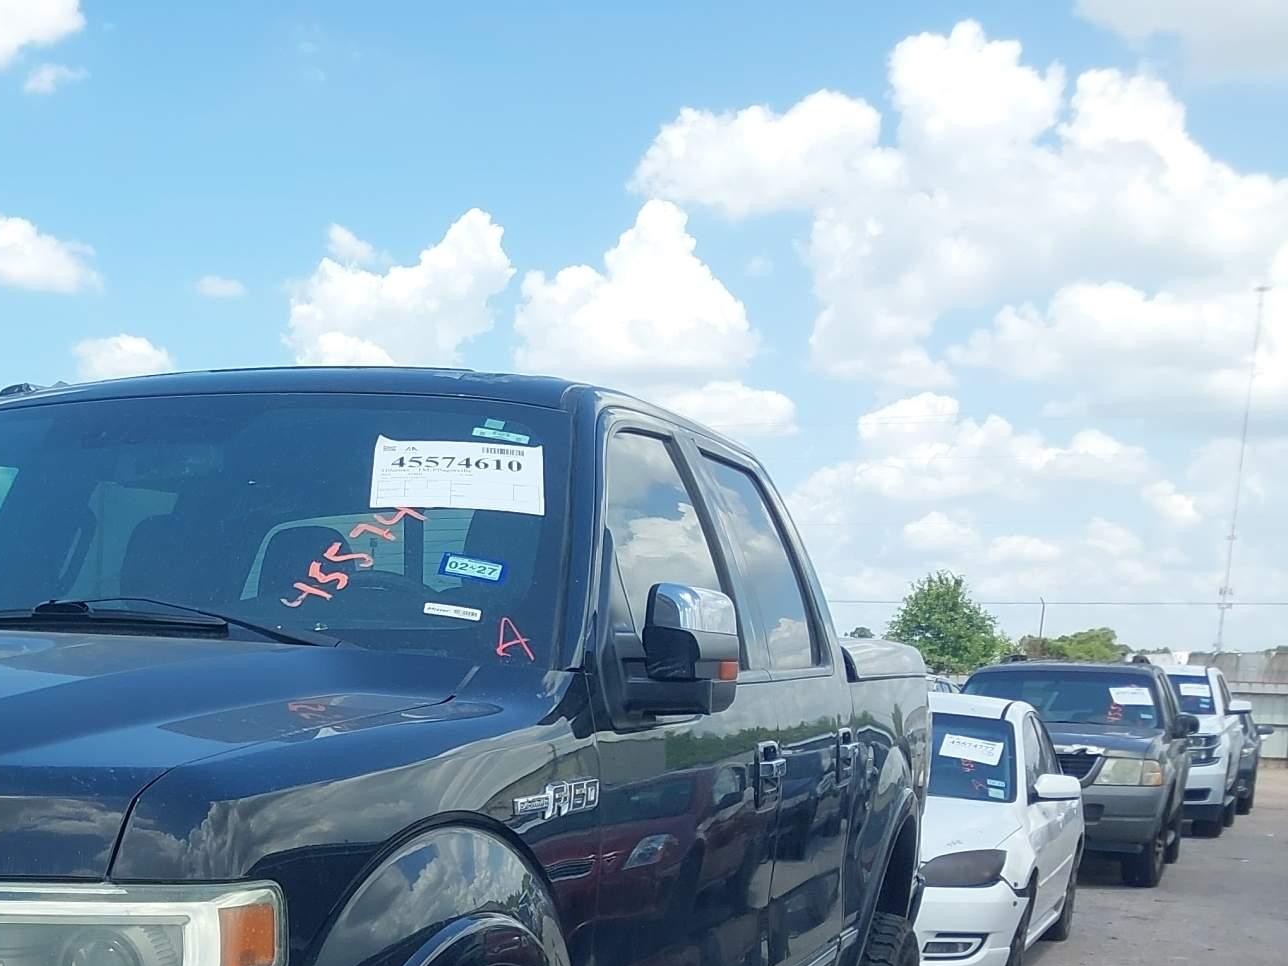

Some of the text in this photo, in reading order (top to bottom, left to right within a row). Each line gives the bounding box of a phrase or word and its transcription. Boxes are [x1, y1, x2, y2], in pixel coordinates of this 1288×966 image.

[391, 456, 523, 473] 45574610
[448, 560, 499, 576] 02-27
[496, 617, 535, 661] A
